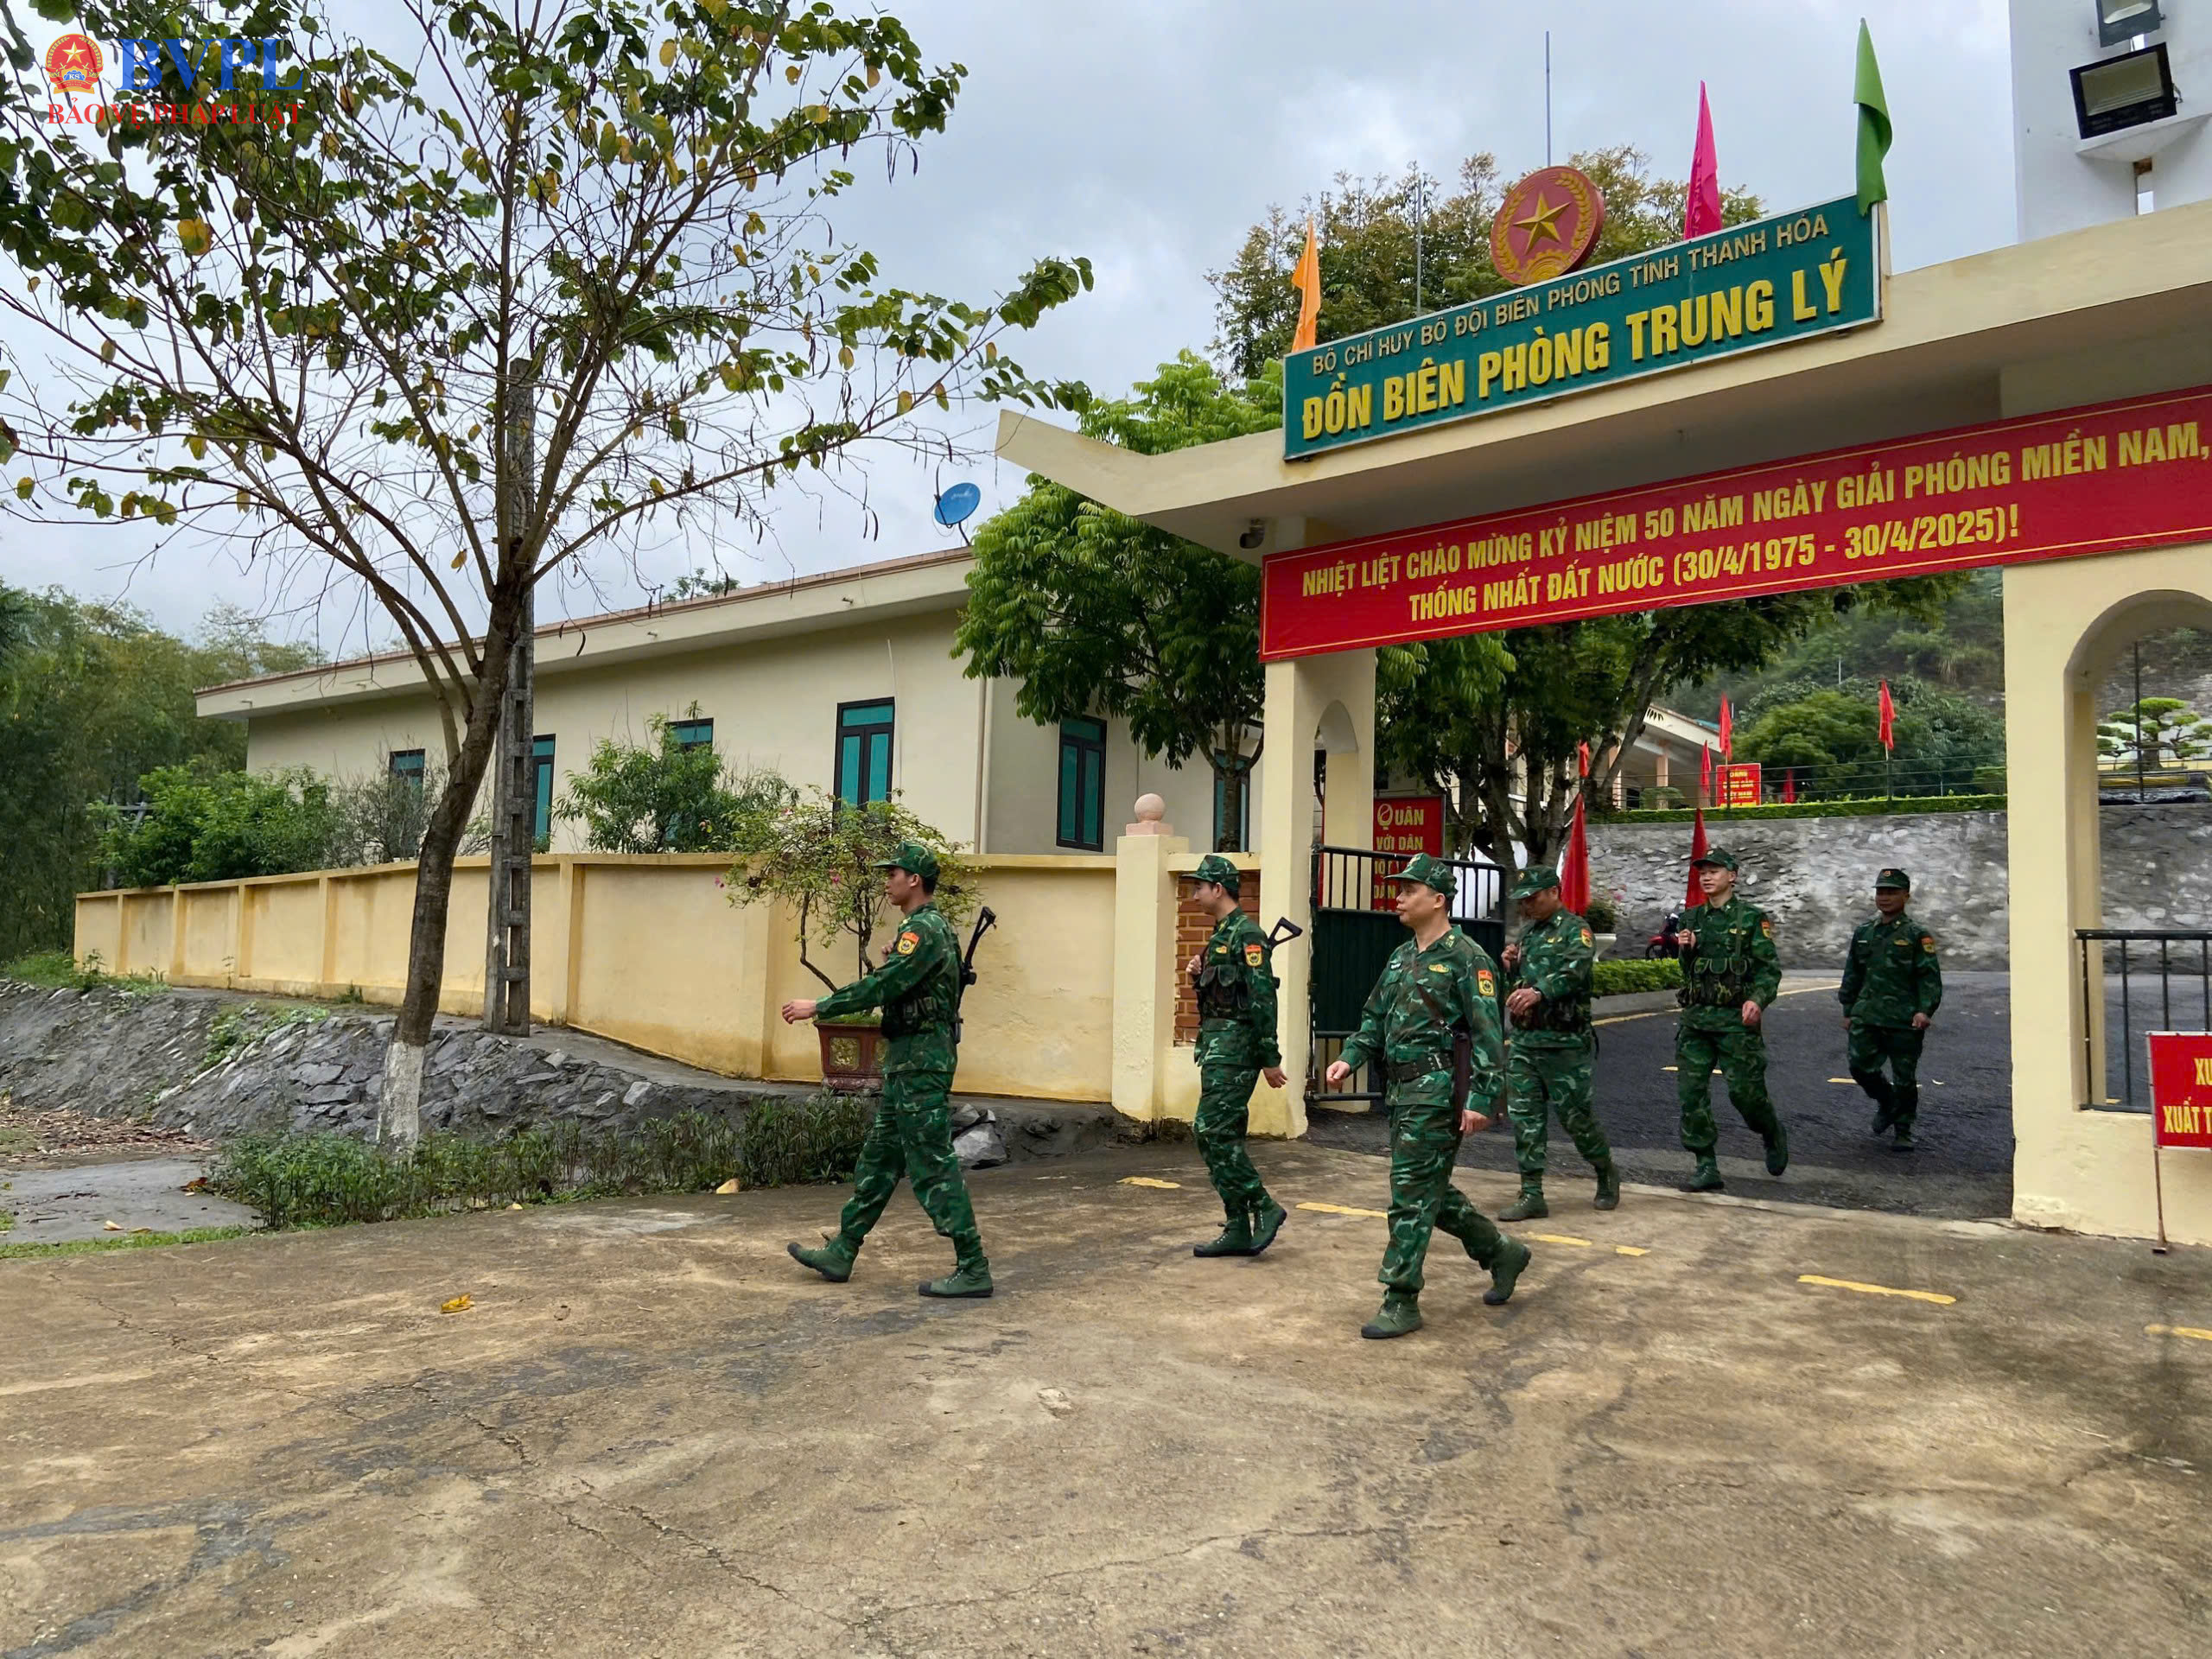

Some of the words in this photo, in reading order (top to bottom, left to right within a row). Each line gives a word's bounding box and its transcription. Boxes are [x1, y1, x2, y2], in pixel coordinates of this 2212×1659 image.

[1302, 372, 1372, 440] ĐỒN
[1383, 357, 1465, 421] BIÊN
[1478, 326, 1610, 398] PHÒNG
[1625, 279, 1774, 361] TRUNG
[1792, 245, 1847, 321] LÝ
[1313, 346, 1338, 376] BỘ
[1378, 330, 1414, 358] HUY
[1421, 317, 1447, 346] BỘ
[1454, 305, 1488, 338] ĐỘI
[1496, 294, 1539, 326] BIÊN
[1548, 275, 1621, 311] PHÒNG
[1688, 229, 1766, 271] THANH
[1302, 560, 1356, 598] NHIỆT
[1361, 551, 1402, 590] LIỆT
[1406, 542, 1460, 580] CHÀO
[1467, 533, 1532, 569] MỪNG
[1539, 516, 1568, 558] KỶ
[1575, 512, 1637, 554] NIỆM
[1644, 507, 1675, 540] 50
[1682, 493, 1744, 534] NĂM
[1752, 477, 1827, 523] NGÀY
[1836, 461, 1895, 509] GIẢI
[1904, 451, 2011, 499] PHÓNG
[2021, 428, 2107, 481] MIỀN
[2118, 421, 2209, 467] NAM,
[1408, 580, 1477, 621] THỐNG
[1484, 567, 1541, 611] NHẤT
[1547, 558, 1592, 602] ĐẤT
[1598, 553, 1664, 594] NƯỚC
[1673, 533, 1815, 586] (30/4/1975
[1376, 804, 1425, 830] QUÂN
[1376, 833, 1395, 851] VỚI
[1398, 833, 1424, 851] DÂN
[2163, 1096, 2201, 1134] XUẤT
